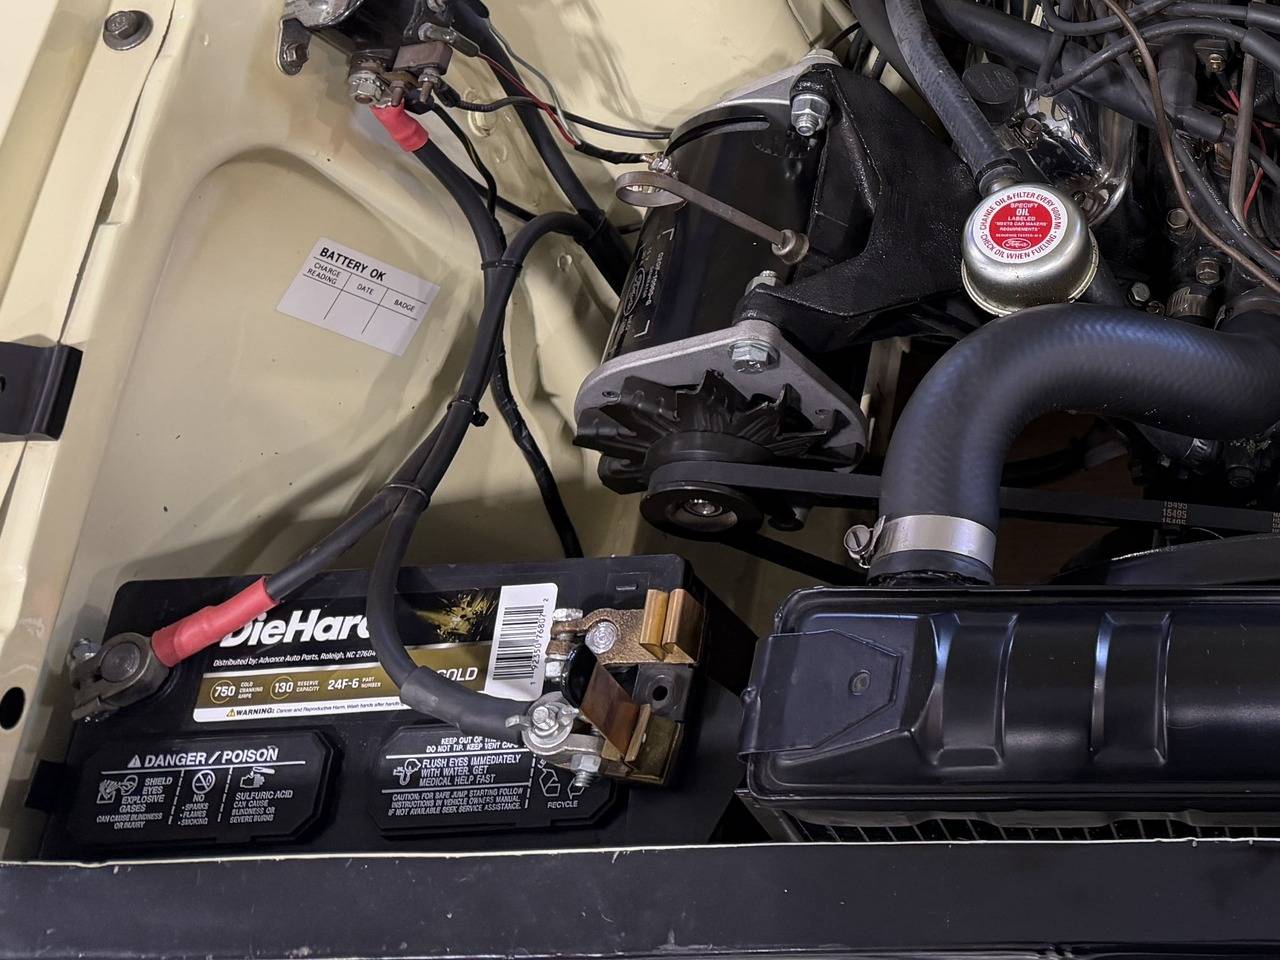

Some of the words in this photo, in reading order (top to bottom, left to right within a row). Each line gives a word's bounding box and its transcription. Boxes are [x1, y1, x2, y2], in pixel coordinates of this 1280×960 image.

[995, 197, 1007, 207] OIL
[1036, 194, 1055, 207] EVERY
[980, 206, 995, 230] CHANGE
[1051, 207, 1061, 220] 6000
[1054, 222, 1061, 230] MI
[981, 234, 995, 251] CHECK
[995, 249, 1004, 258] OIL
[1032, 234, 1057, 255] FUELING
[314, 262, 341, 277] CHARGE
[320, 247, 368, 273] BATTERY
[370, 269, 386, 281] OK
[307, 268, 337, 285] READING
[356, 284, 374, 295] DATE
[394, 299, 415, 312] BADGE
[213, 658, 248, 667] Distributed
[320, 651, 345, 660] Raleigh,
[531, 643, 542, 671] 92350
[274, 682, 293, 693] 130
[328, 678, 359, 690] 24F-6
[214, 686, 236, 697] 750
[144, 752, 207, 767] DANGER
[208, 751, 221, 764] /
[222, 748, 278, 763] POISON
[422, 758, 447, 768] FLUSH
[449, 757, 468, 766] EYES
[471, 754, 521, 765] IMMEDIATELY
[421, 768, 440, 777] WITH
[443, 767, 470, 776] WATER.
[473, 766, 488, 774] GET
[145, 777, 173, 786] SHIELD
[419, 777, 452, 786] MEDICAL
[454, 776, 474, 785] HELP
[476, 774, 496, 783] FAST
[142, 786, 163, 794] EYES
[236, 792, 274, 800] SULFURIC
[275, 790, 293, 799] ACID
[392, 793, 420, 801] CAUTION:
[469, 788, 498, 797] STARTING
[122, 795, 165, 804] EXPLOSIVE
[391, 800, 434, 808] INSTRUCTIONS
[469, 796, 494, 804] OWNERS
[119, 804, 146, 813] GASES
[410, 807, 441, 815] AVAILABLE
[458, 804, 483, 812] SERVICE
[110, 814, 130, 822] CAUSE
[130, 813, 163, 821] BLINDNESS
